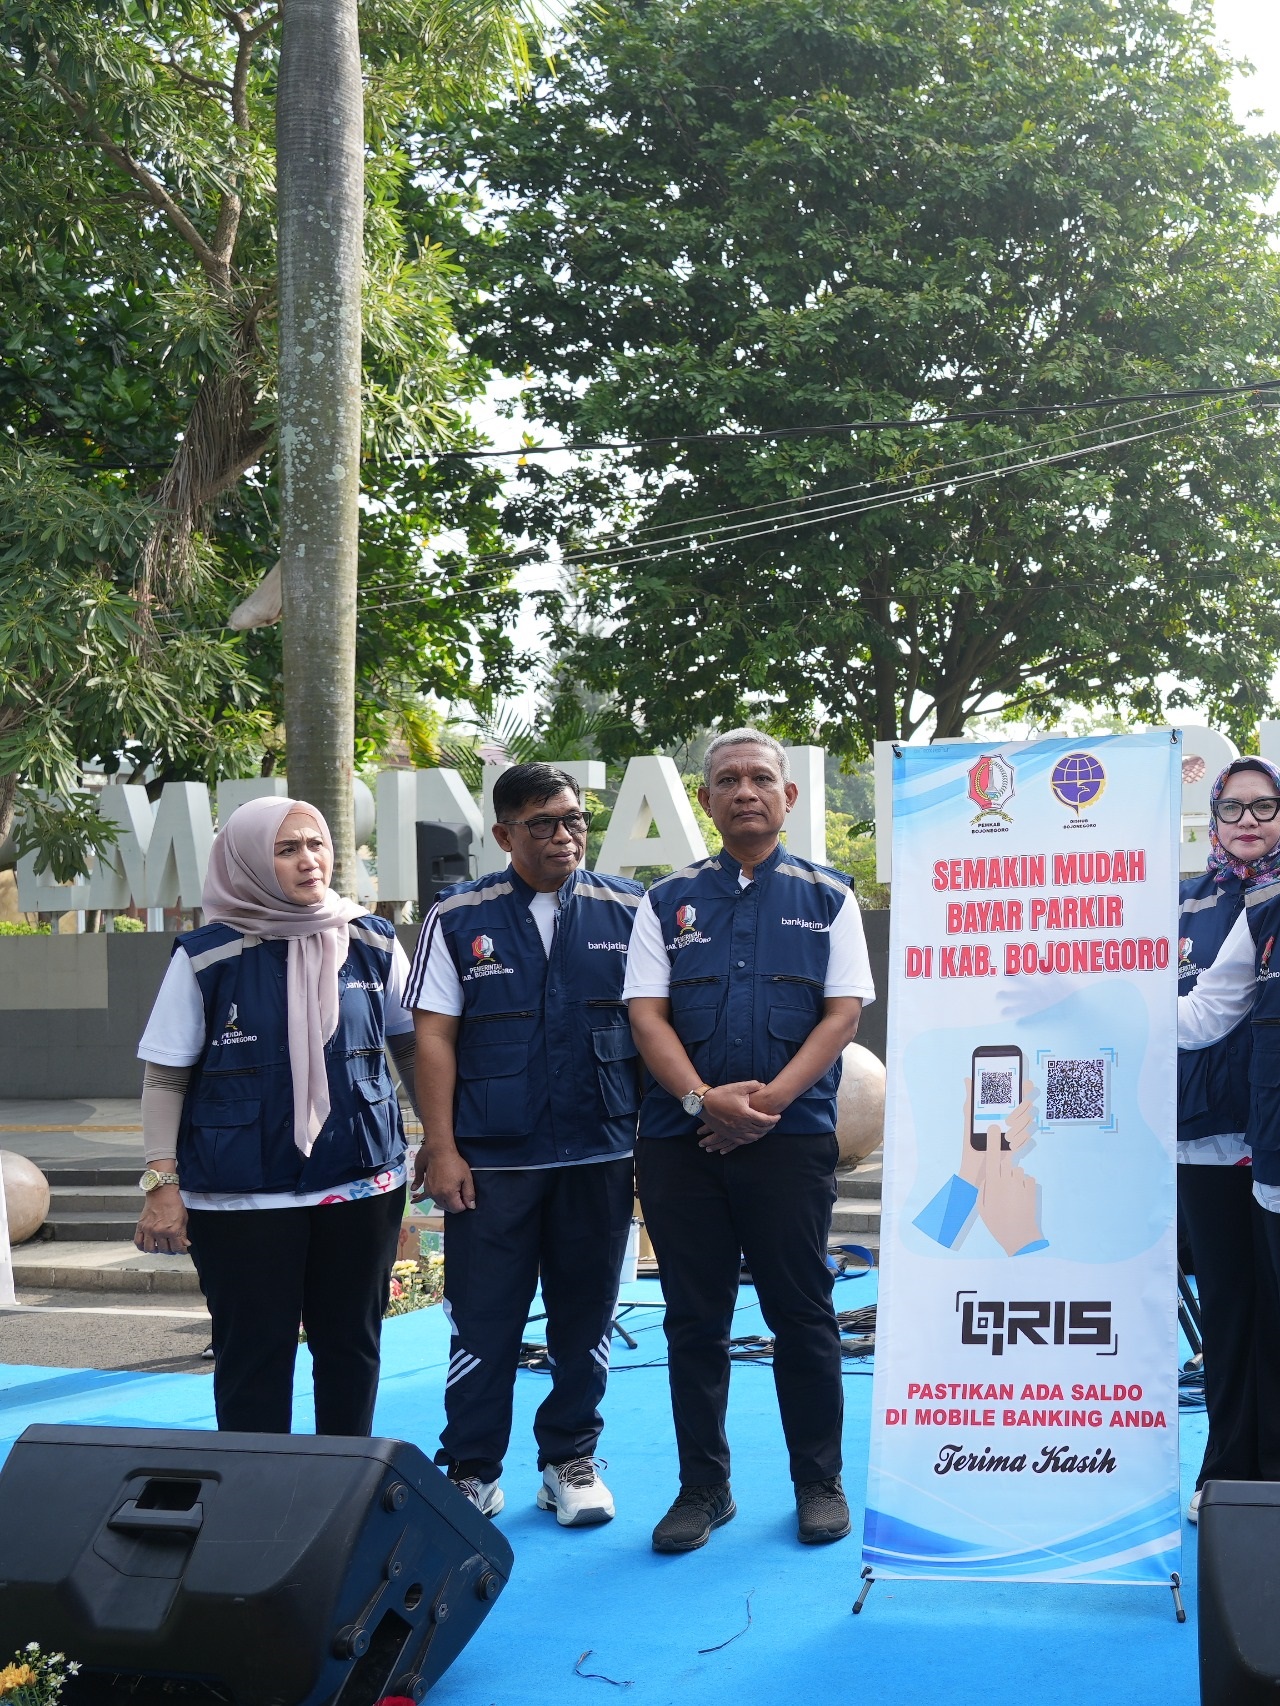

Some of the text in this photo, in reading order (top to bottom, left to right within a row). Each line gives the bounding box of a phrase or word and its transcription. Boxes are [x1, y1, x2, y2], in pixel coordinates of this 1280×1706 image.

[932, 849, 1146, 891] SEMAKIN MUDAH
[781, 917, 823, 930] bankjatim
[946, 895, 1124, 935] BAYAR PARKIR
[588, 941, 628, 952] bankjatim
[905, 937, 1169, 979] DI KAB. BOJONEGORO
[961, 1301, 1111, 1355] QRIS
[907, 1383, 1143, 1402] PASTIKAN ADA SALDO
[885, 1409, 1167, 1428] DI MOBILE BANKING ANDA
[934, 1444, 1117, 1475] Terima Kasih
